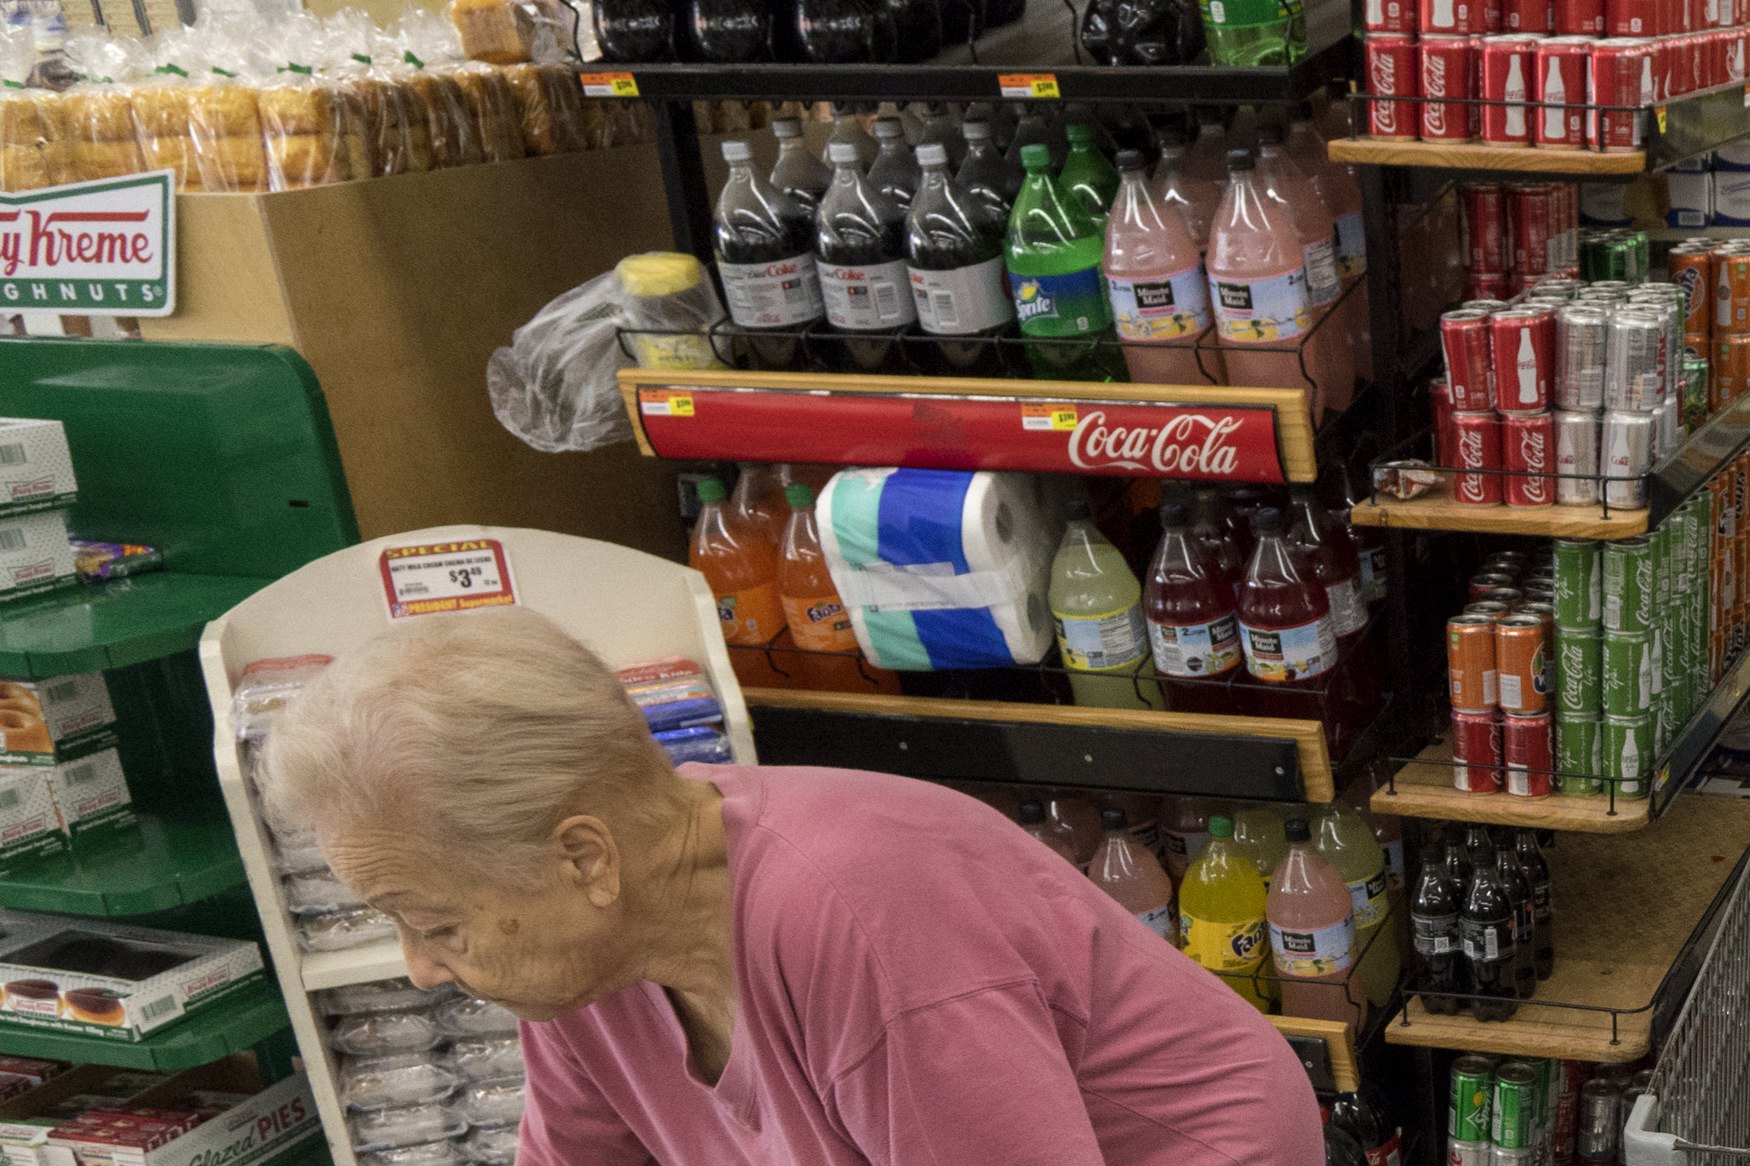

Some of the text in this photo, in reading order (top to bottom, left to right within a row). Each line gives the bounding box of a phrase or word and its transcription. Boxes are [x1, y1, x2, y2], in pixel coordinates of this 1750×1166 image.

[25, 209, 153, 267] Kreme
[765, 262, 797, 278] Coke
[833, 267, 865, 281] Coke
[1068, 411, 1244, 474] Coca-Cola
[386, 541, 488, 558] SPECIAL
[1232, 926, 1266, 956] Fan
[257, 1096, 306, 1141] PIES
